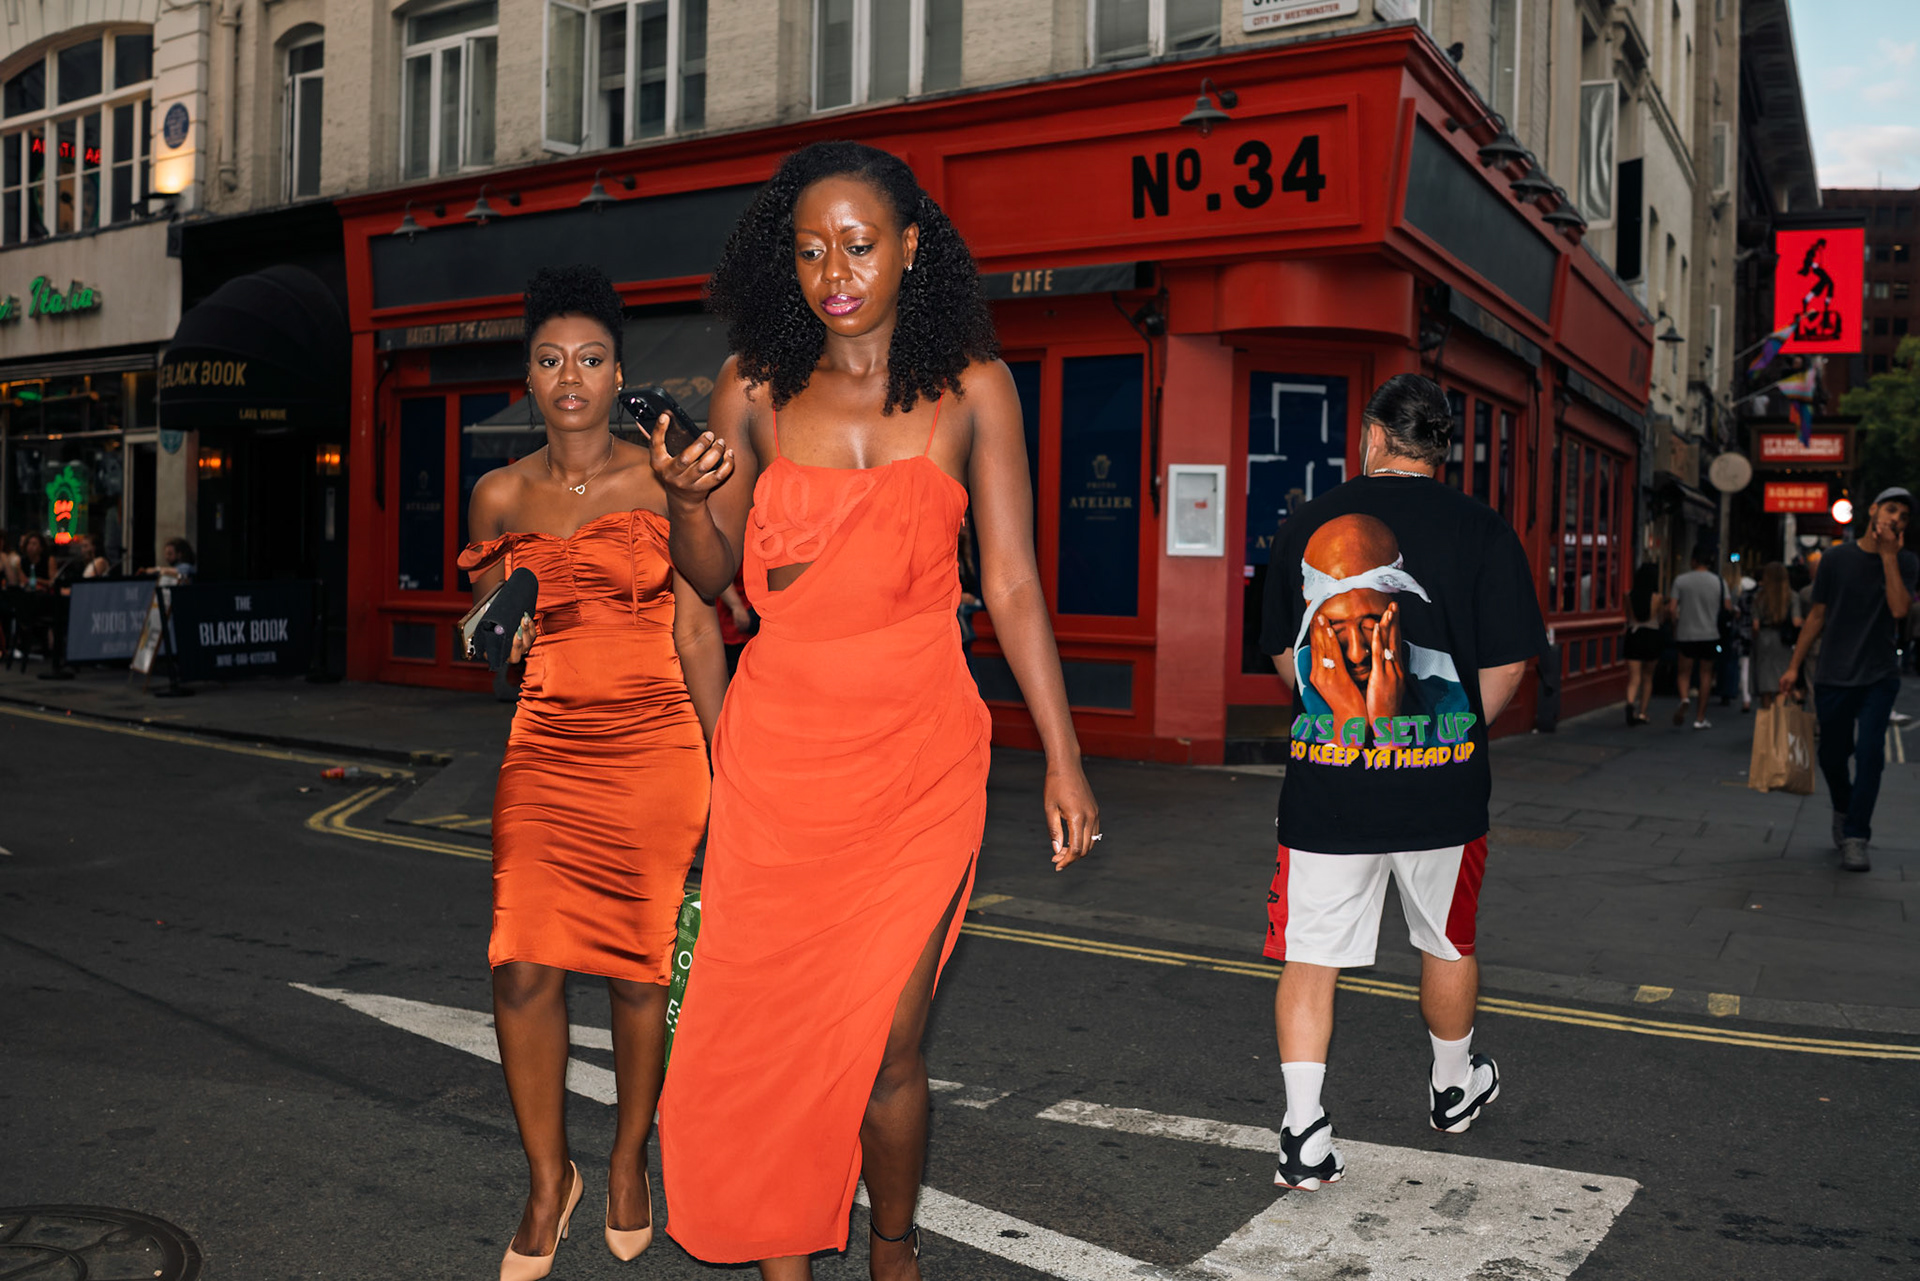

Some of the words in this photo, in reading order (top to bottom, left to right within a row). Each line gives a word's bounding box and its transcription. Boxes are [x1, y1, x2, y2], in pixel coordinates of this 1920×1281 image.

[1253, 14, 1270, 26] CITY
[1272, 12, 1282, 23] OF
[1284, 3, 1340, 19] WESTMINSTER
[1012, 269, 1054, 293] CAFE
[29, 276, 96, 318] Italia
[200, 360, 248, 387] BOOK
[1070, 496, 1132, 509] ATELIER
[235, 595, 252, 611] THE
[199, 621, 246, 647] BLACK
[250, 618, 289, 644] BOOK
[1341, 716, 1367, 749] A
[1372, 714, 1432, 748] SET
[1436, 711, 1478, 743] UP
[1290, 739, 1308, 762] SO
[1309, 743, 1361, 768] KEEP
[1362, 748, 1392, 772] YA
[1394, 746, 1452, 771] HEAD
[1453, 741, 1477, 764] UP
